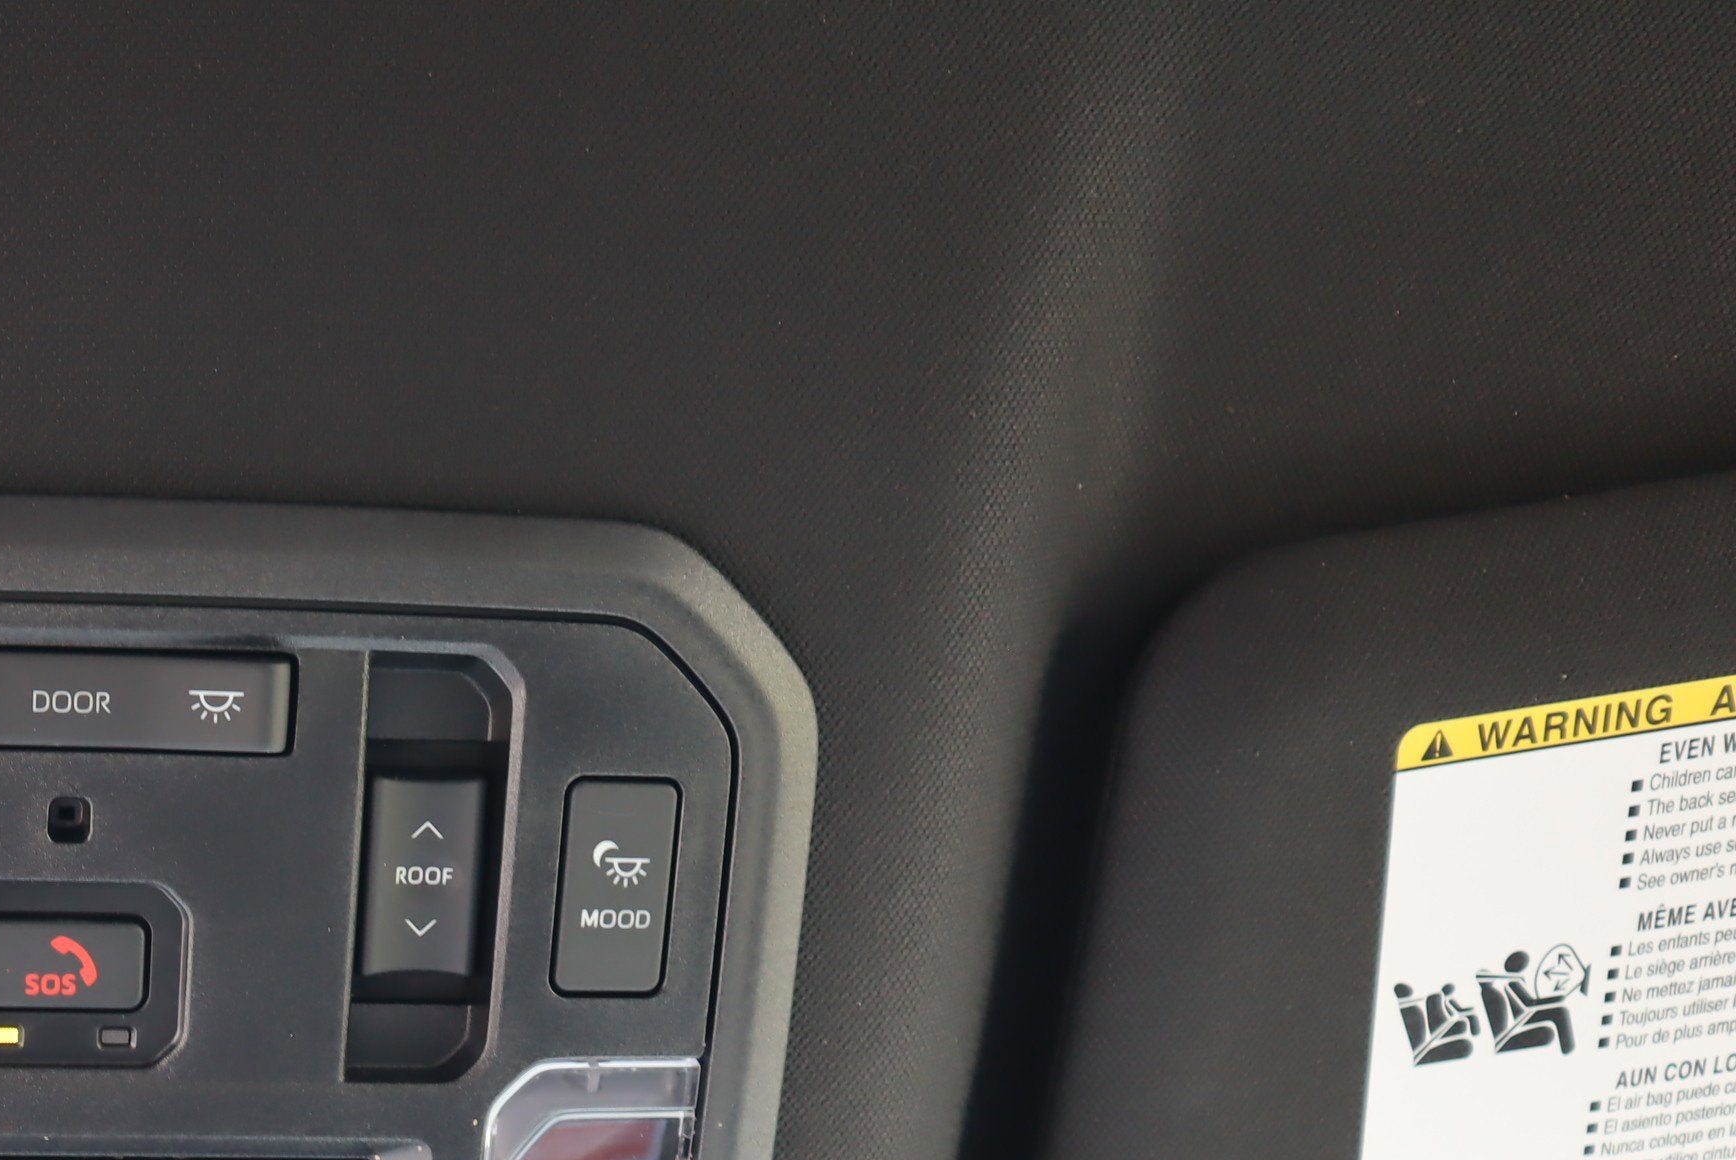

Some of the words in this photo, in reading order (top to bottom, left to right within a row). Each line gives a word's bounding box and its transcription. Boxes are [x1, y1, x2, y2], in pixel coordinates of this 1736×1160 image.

[31, 690, 111, 714] DOOR
[1478, 694, 1673, 752] WARNING
[1659, 735, 1715, 764] EVEN
[1650, 768, 1711, 791] Children
[1648, 797, 1674, 816] The
[1679, 790, 1714, 812] back
[1643, 822, 1686, 841] Never
[1689, 814, 1714, 838] put
[1718, 816, 1727, 830] a
[1640, 846, 1691, 866] Always
[1695, 841, 1722, 858] use
[395, 866, 454, 886] ROOF
[1637, 872, 1666, 890] See
[1670, 862, 1725, 885] owner's
[580, 909, 651, 930] MOOD
[1637, 903, 1697, 932] MÊME
[1628, 939, 1653, 957] Les
[1658, 931, 1710, 951] enfants
[1625, 964, 1642, 980] Le
[1647, 957, 1685, 978] siège
[25, 973, 77, 996] SOS
[1622, 988, 1642, 1003] Ne
[1646, 980, 1694, 1000] mettez
[1620, 1005, 1678, 1028] Toujours
[1683, 997, 1729, 1017] utiliser
[1616, 1032, 1648, 1049] Pour
[1652, 1028, 1669, 1044] de
[1674, 1025, 1703, 1044] plus
[1616, 1066, 1657, 1089] AUN
[1664, 1058, 1707, 1082] CON
[1607, 1096, 1620, 1113] El
[1625, 1093, 1642, 1110] air
[1646, 1090, 1672, 1108] bag
[1676, 1082, 1720, 1105] puede
[1604, 1119, 1617, 1135] El
[1622, 1113, 1672, 1132] asiento
[1601, 1138, 1645, 1156] Nunca
[1649, 1130, 1703, 1148] coloque
[1708, 1126, 1725, 1140] en
